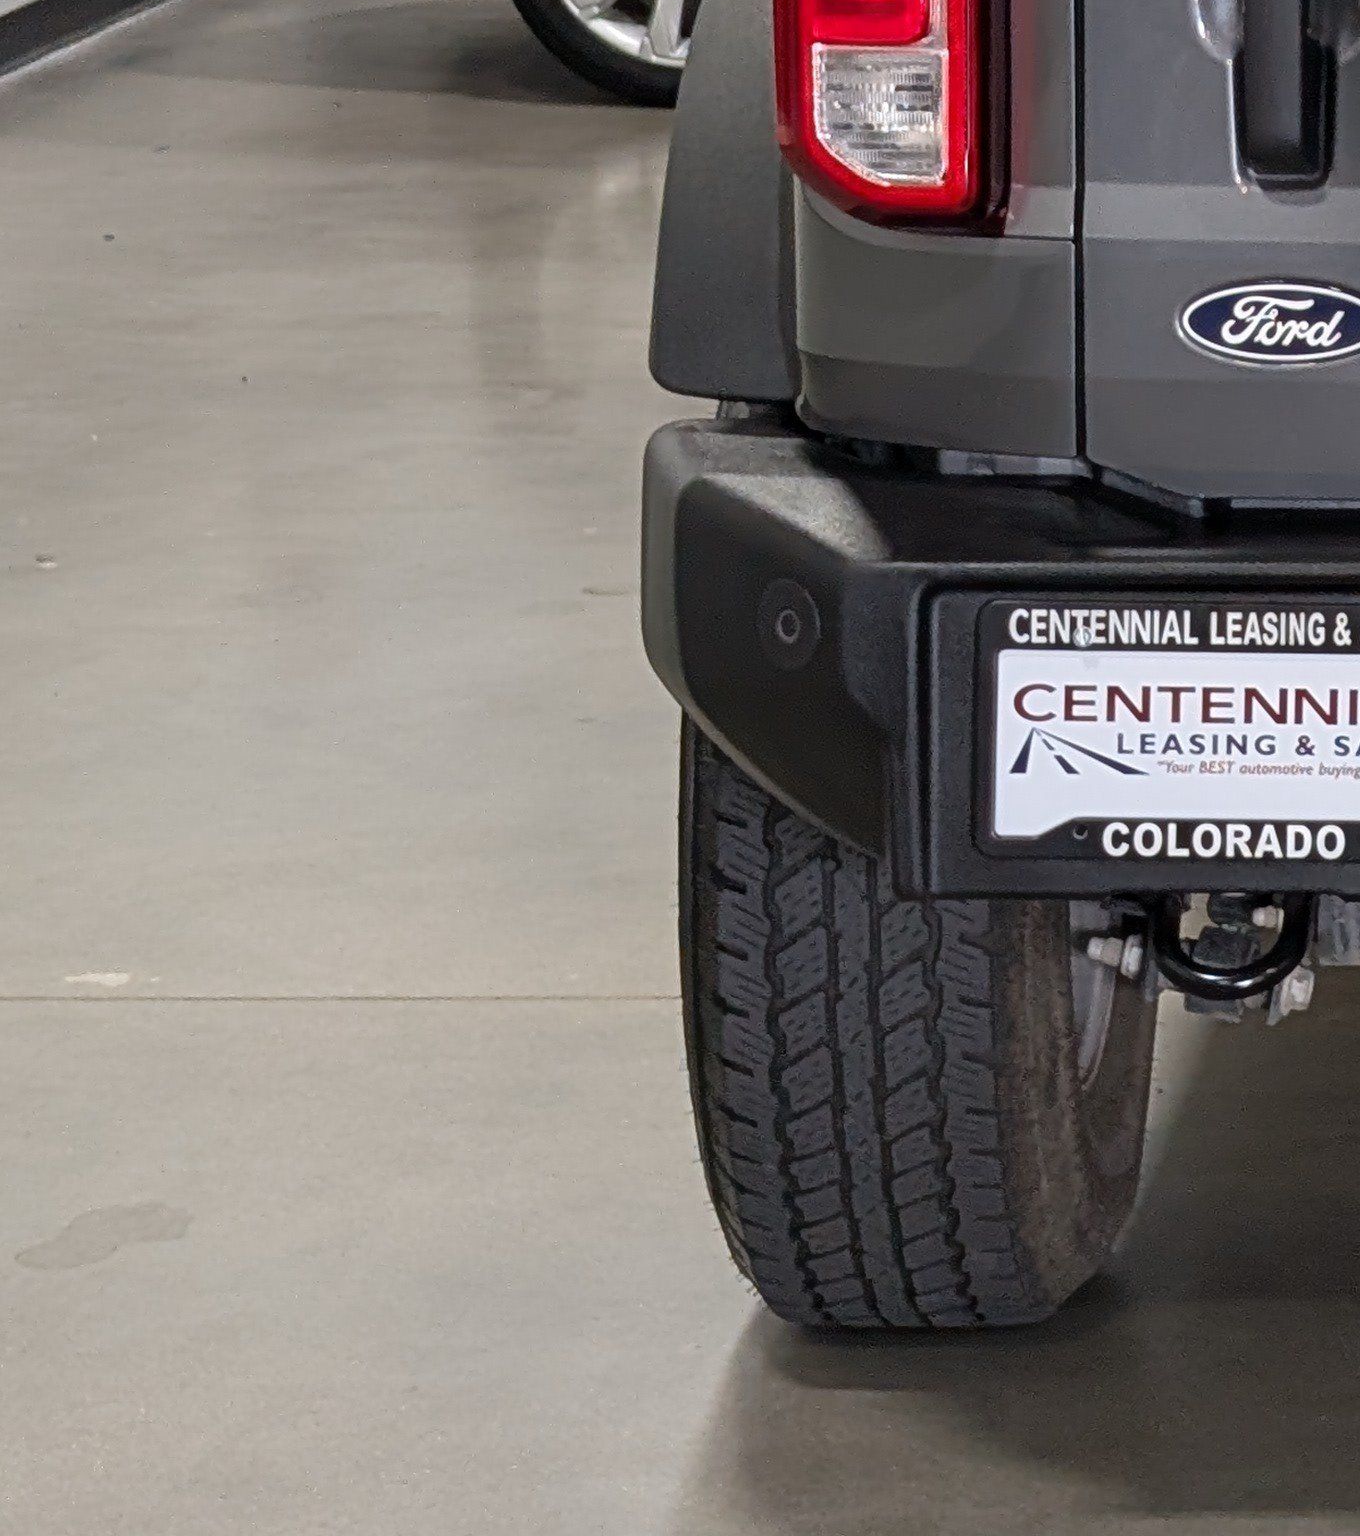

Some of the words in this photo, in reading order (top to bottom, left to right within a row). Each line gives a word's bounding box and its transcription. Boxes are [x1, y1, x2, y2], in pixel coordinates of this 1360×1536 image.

[1220, 295, 1345, 347] Ford
[1008, 608, 1199, 645] CENTENNIAL
[1209, 611, 1326, 646] LEASING
[1333, 612, 1352, 646] &
[1117, 733, 1277, 756] LEASING
[1295, 735, 1315, 756] &
[1199, 760, 1235, 774] BEST
[1239, 763, 1313, 776] automotive
[1102, 822, 1346, 860] COLORADO
